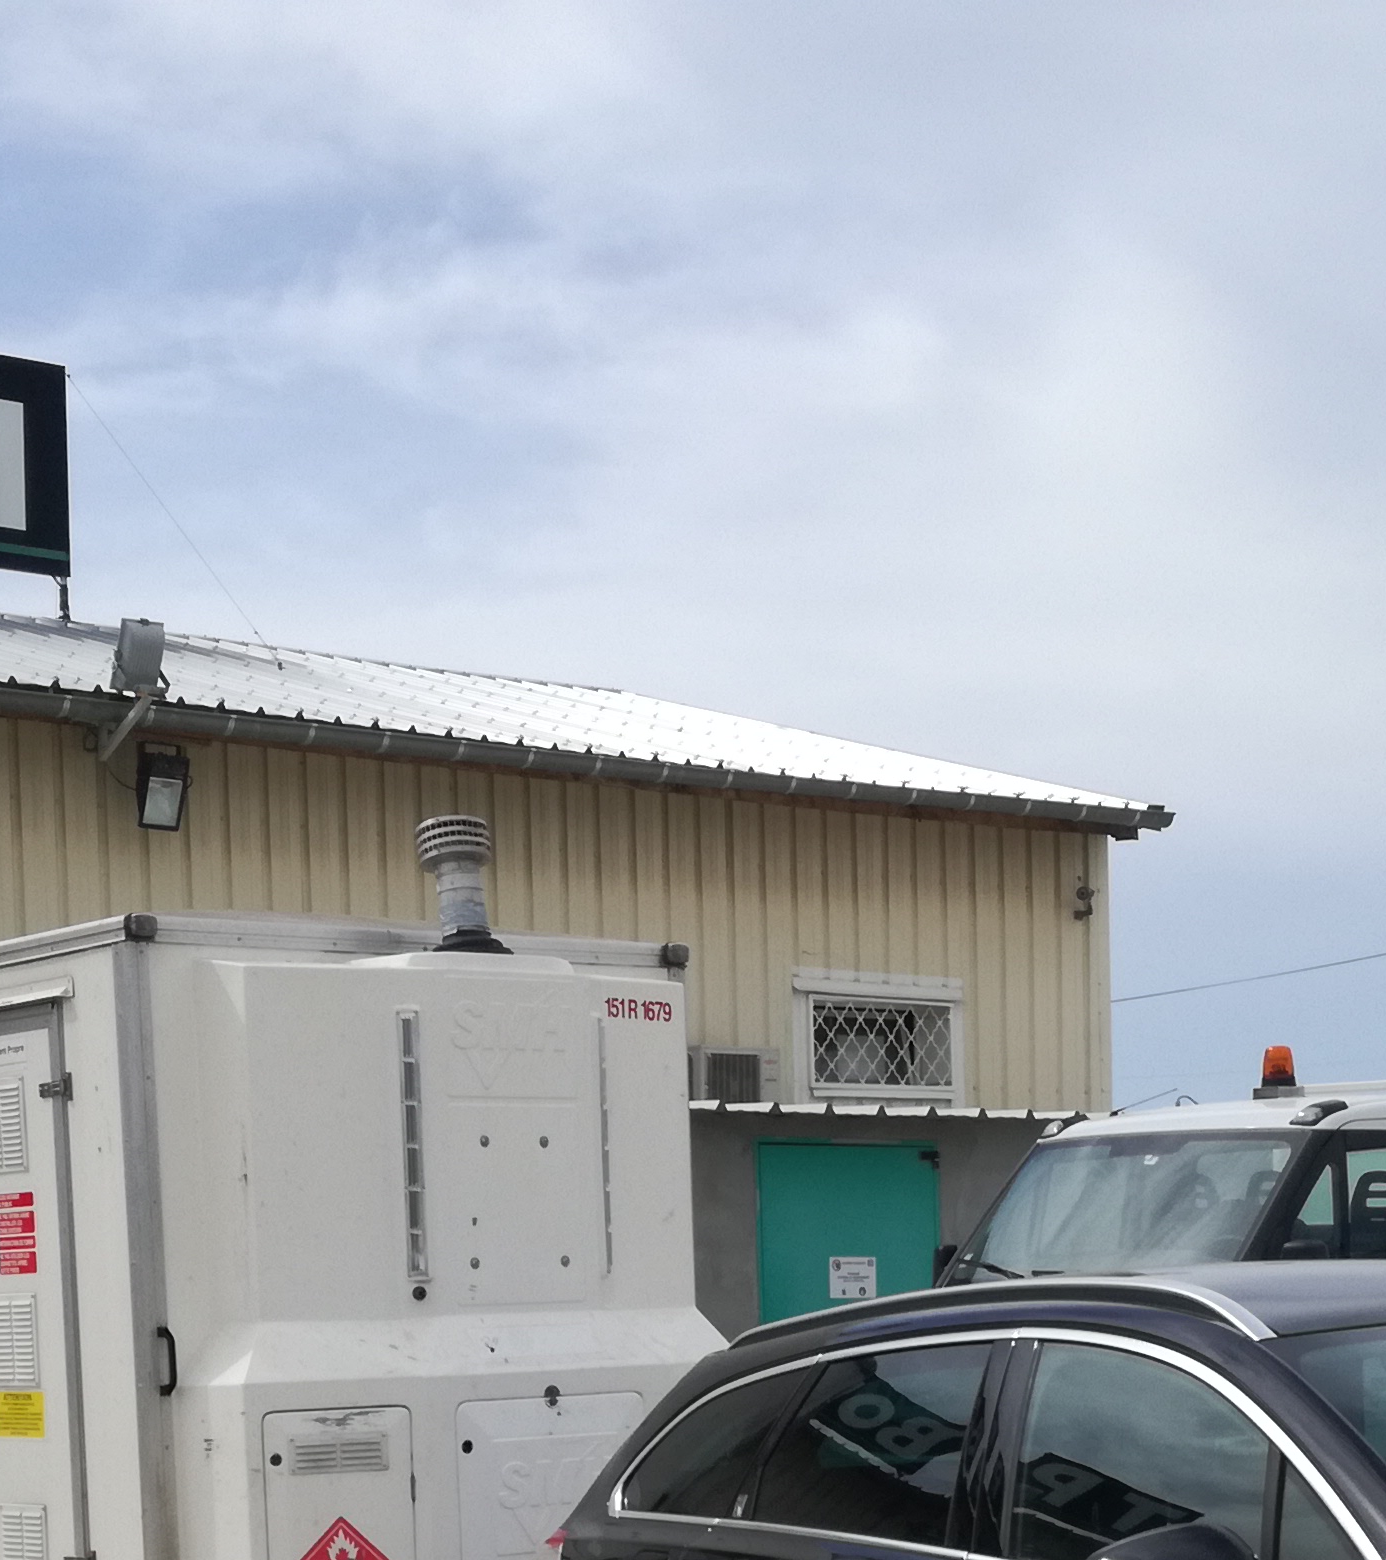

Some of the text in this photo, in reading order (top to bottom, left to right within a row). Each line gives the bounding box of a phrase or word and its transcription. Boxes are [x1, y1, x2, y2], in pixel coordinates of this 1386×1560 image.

[605, 997, 672, 1022] 151 R 1679
